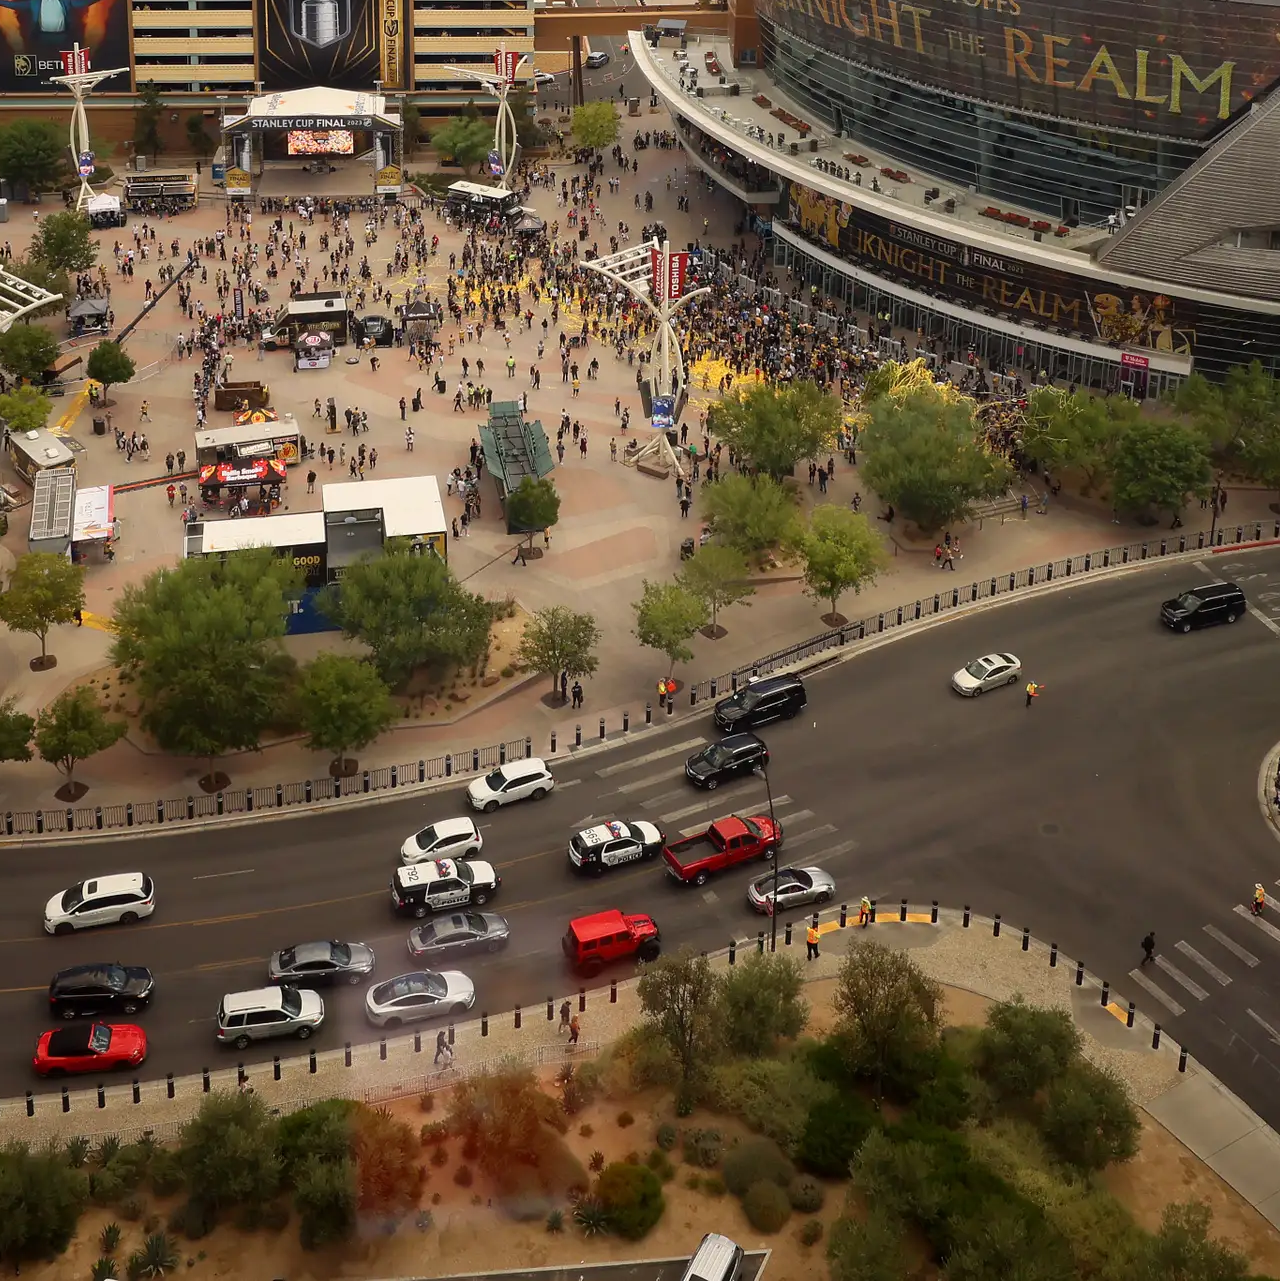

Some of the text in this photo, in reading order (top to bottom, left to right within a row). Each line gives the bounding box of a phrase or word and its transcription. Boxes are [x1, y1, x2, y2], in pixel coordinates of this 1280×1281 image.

[386, 0, 395, 18] CUP
[387, 39, 396, 67] FINAL
[944, 28, 986, 57] THE
[1003, 26, 1237, 120] REALM
[252, 119, 294, 128] STANLEY
[296, 119, 315, 128] CUP
[316, 118, 346, 128] FINAL
[897, 227, 937, 249] STANLEY
[937, 242, 958, 256] CUP
[973, 252, 1006, 271] FINAL
[671, 255, 680, 297] TOSHIBA
[955, 272, 976, 288] THE
[982, 275, 1082, 329] REALM
[293, 555, 320, 566] GOOD
[584, 827, 601, 844] 565
[617, 851, 642, 863] POLICE
[405, 866, 419, 881] 792
[441, 896, 469, 905] POLICE
